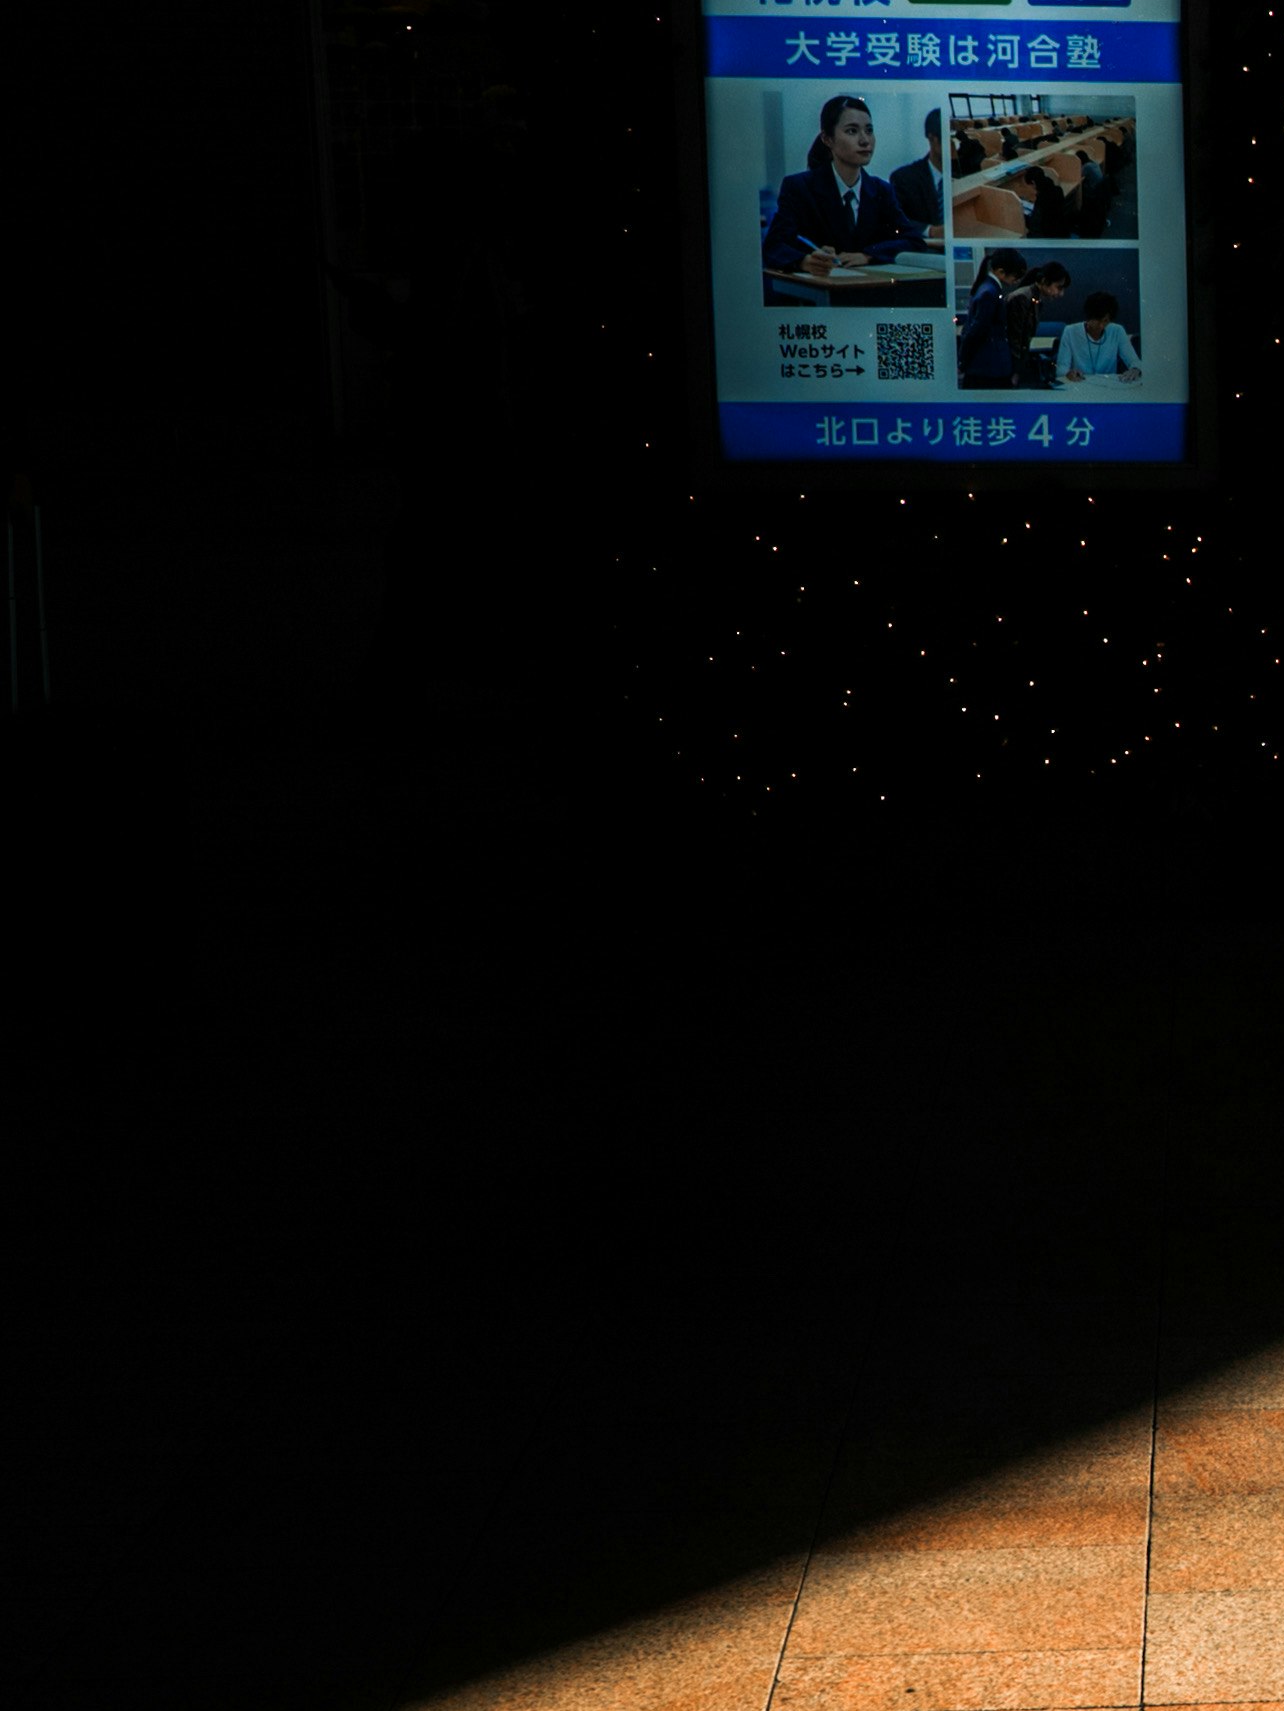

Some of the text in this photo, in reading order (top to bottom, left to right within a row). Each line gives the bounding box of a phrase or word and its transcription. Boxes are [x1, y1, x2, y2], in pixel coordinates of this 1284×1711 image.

[785, 31, 1102, 70] 大学受験は河合塾
[778, 323, 828, 341] 札幌校
[779, 344, 866, 360] Webサイト
